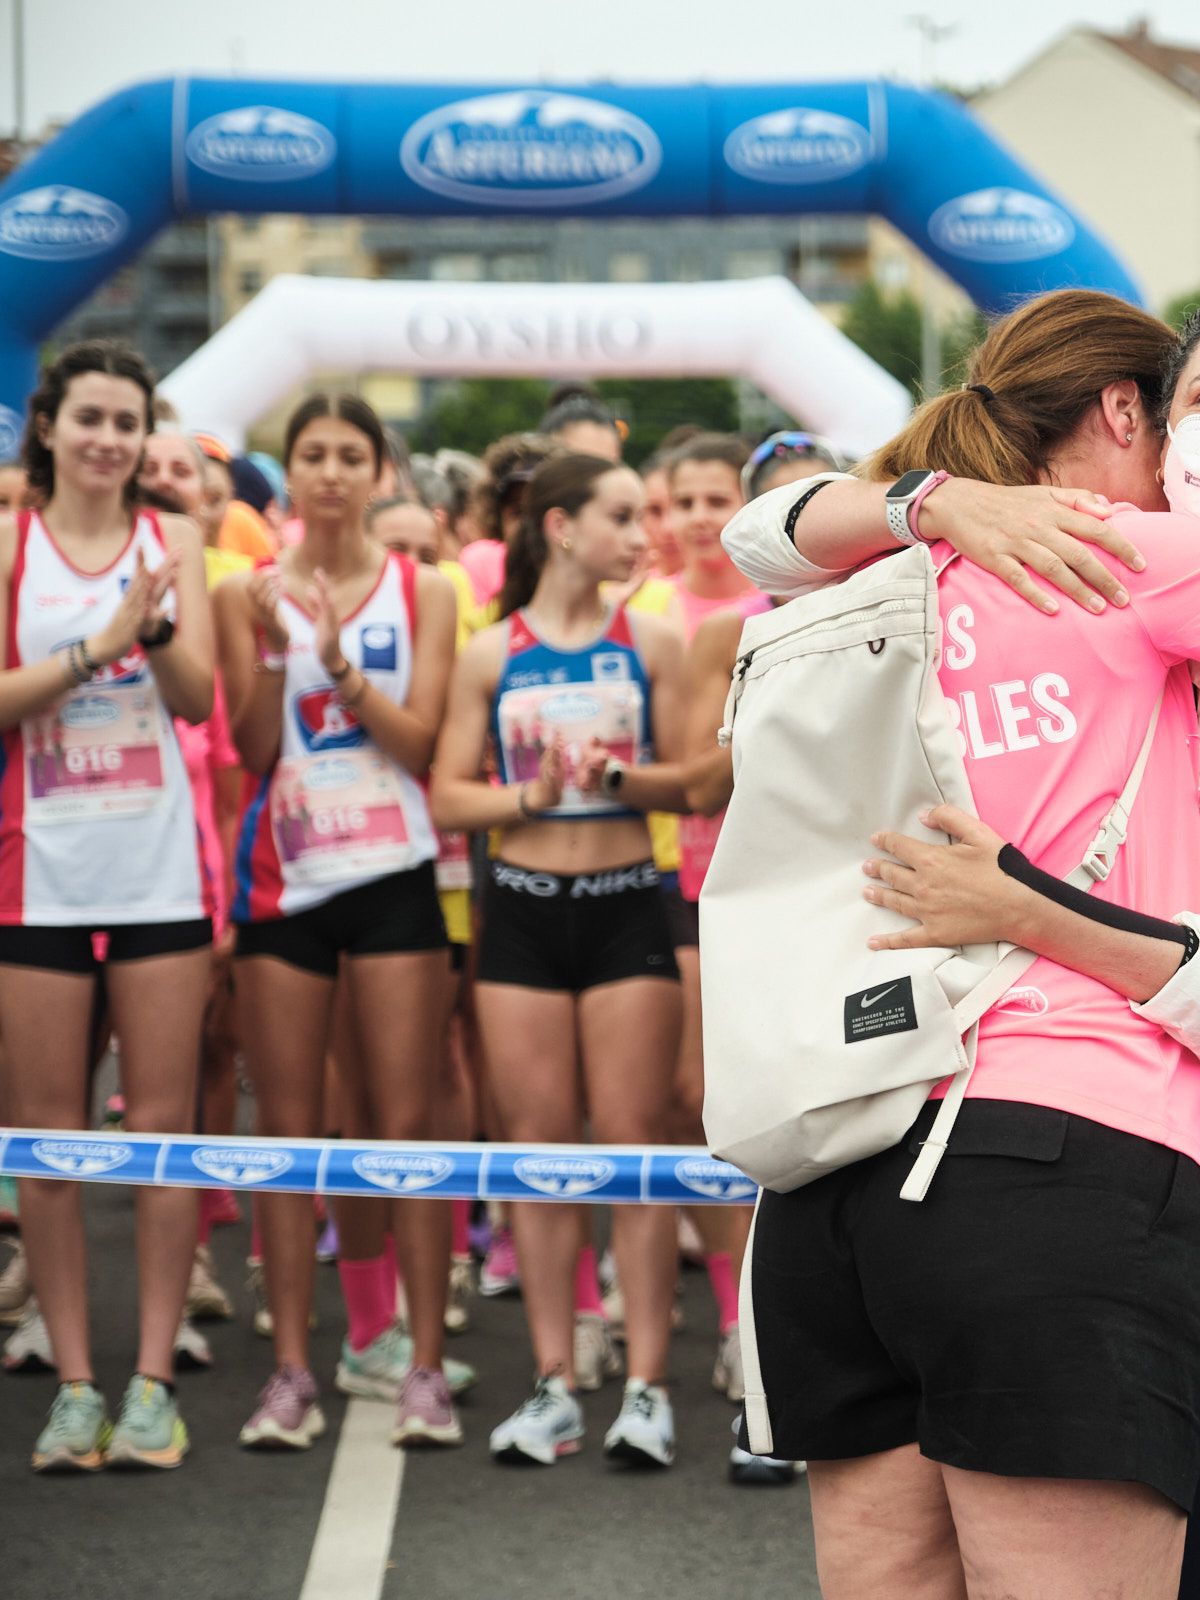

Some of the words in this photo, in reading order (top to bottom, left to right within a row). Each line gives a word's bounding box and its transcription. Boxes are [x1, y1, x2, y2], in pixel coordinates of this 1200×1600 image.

[406, 302, 655, 359] OYSHO
[937, 604, 976, 671] S
[65, 745, 123, 774] 016
[312, 805, 369, 836] 016
[570, 862, 660, 898] NIKE
[852, 1012, 882, 1023] ENGINEERED
[852, 1021, 864, 1029] EXACT
[865, 1013, 899, 1025] SPECIFICATIONS
[853, 1024, 883, 1034] CHAMPIONSHIP
[885, 1018, 906, 1026] ATHLETES
